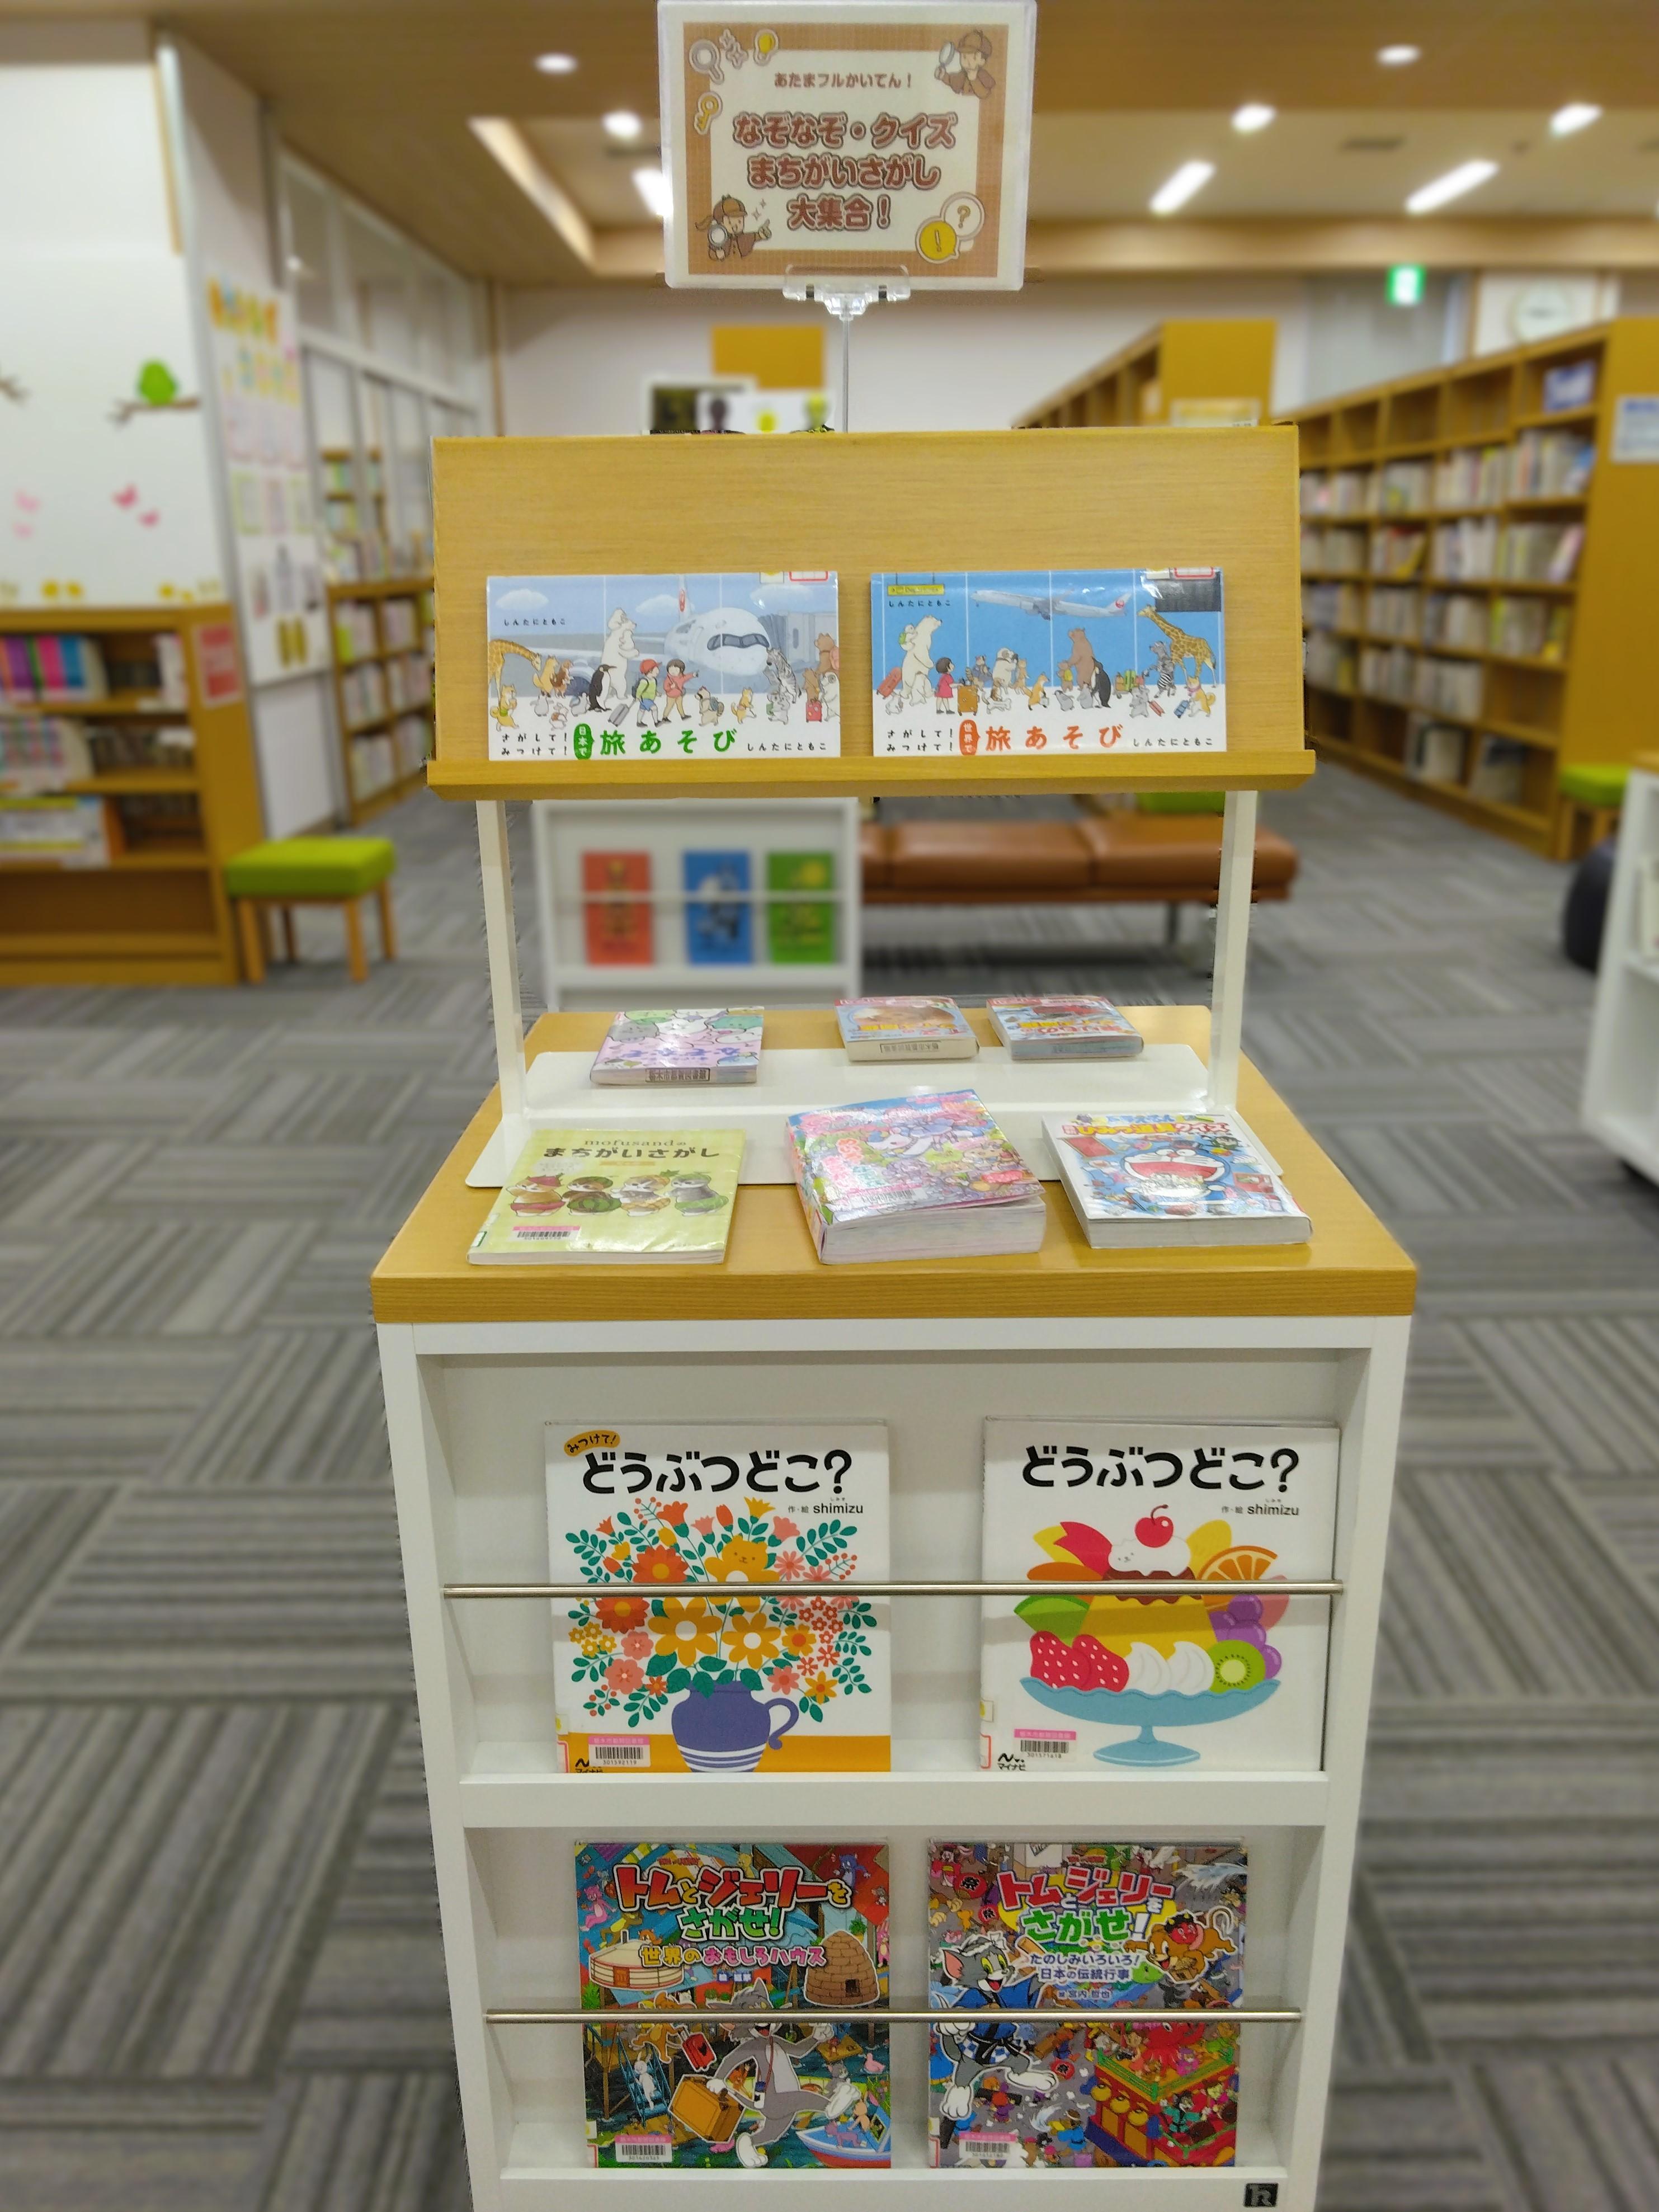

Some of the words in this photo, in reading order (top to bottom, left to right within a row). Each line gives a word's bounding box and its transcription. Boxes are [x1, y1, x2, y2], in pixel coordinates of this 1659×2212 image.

[774, 72, 912, 89] あたまフルかいてん！
[733, 112, 958, 149] なぞなぞ・クイズ
[747, 153, 941, 189] まちがいさがし
[787, 194, 891, 231] 大集合！
[502, 733, 567, 742] さがして！
[578, 727, 588, 757] 日本で
[600, 728, 737, 755] 旅あそび
[887, 728, 953, 738] さがして！
[986, 723, 1123, 752] 旅あそび
[1133, 737, 1213, 747] しんたにともこ
[501, 747, 567, 756] みつけて！
[747, 742, 827, 752] しんたにともこ
[887, 742, 953, 752] みつけて！
[544, 1147, 719, 1159] まちがいさがし
[567, 1434, 616, 1453] みつけて！
[582, 1449, 852, 1494] どうぶつどこ？
[1022, 1445, 1299, 1493] どうぶつどこ？
[813, 1503, 864, 1514] shimizu
[1247, 1503, 1299, 1516] shimizu
[998, 1763, 1026, 1771] マイナビ
[615, 1865, 850, 1909] トムとジェリーを
[998, 1867, 1173, 1913] トムとジェリーを
[679, 1907, 783, 1940] さがせ！
[1024, 1910, 1148, 1942] さがせ！
[642, 1946, 826, 1966] 世界のおもしろハウス
[1030, 1954, 1140, 1966] たのしみいろいろ！
[1041, 1968, 1129, 1979] 日本の伝統行事
